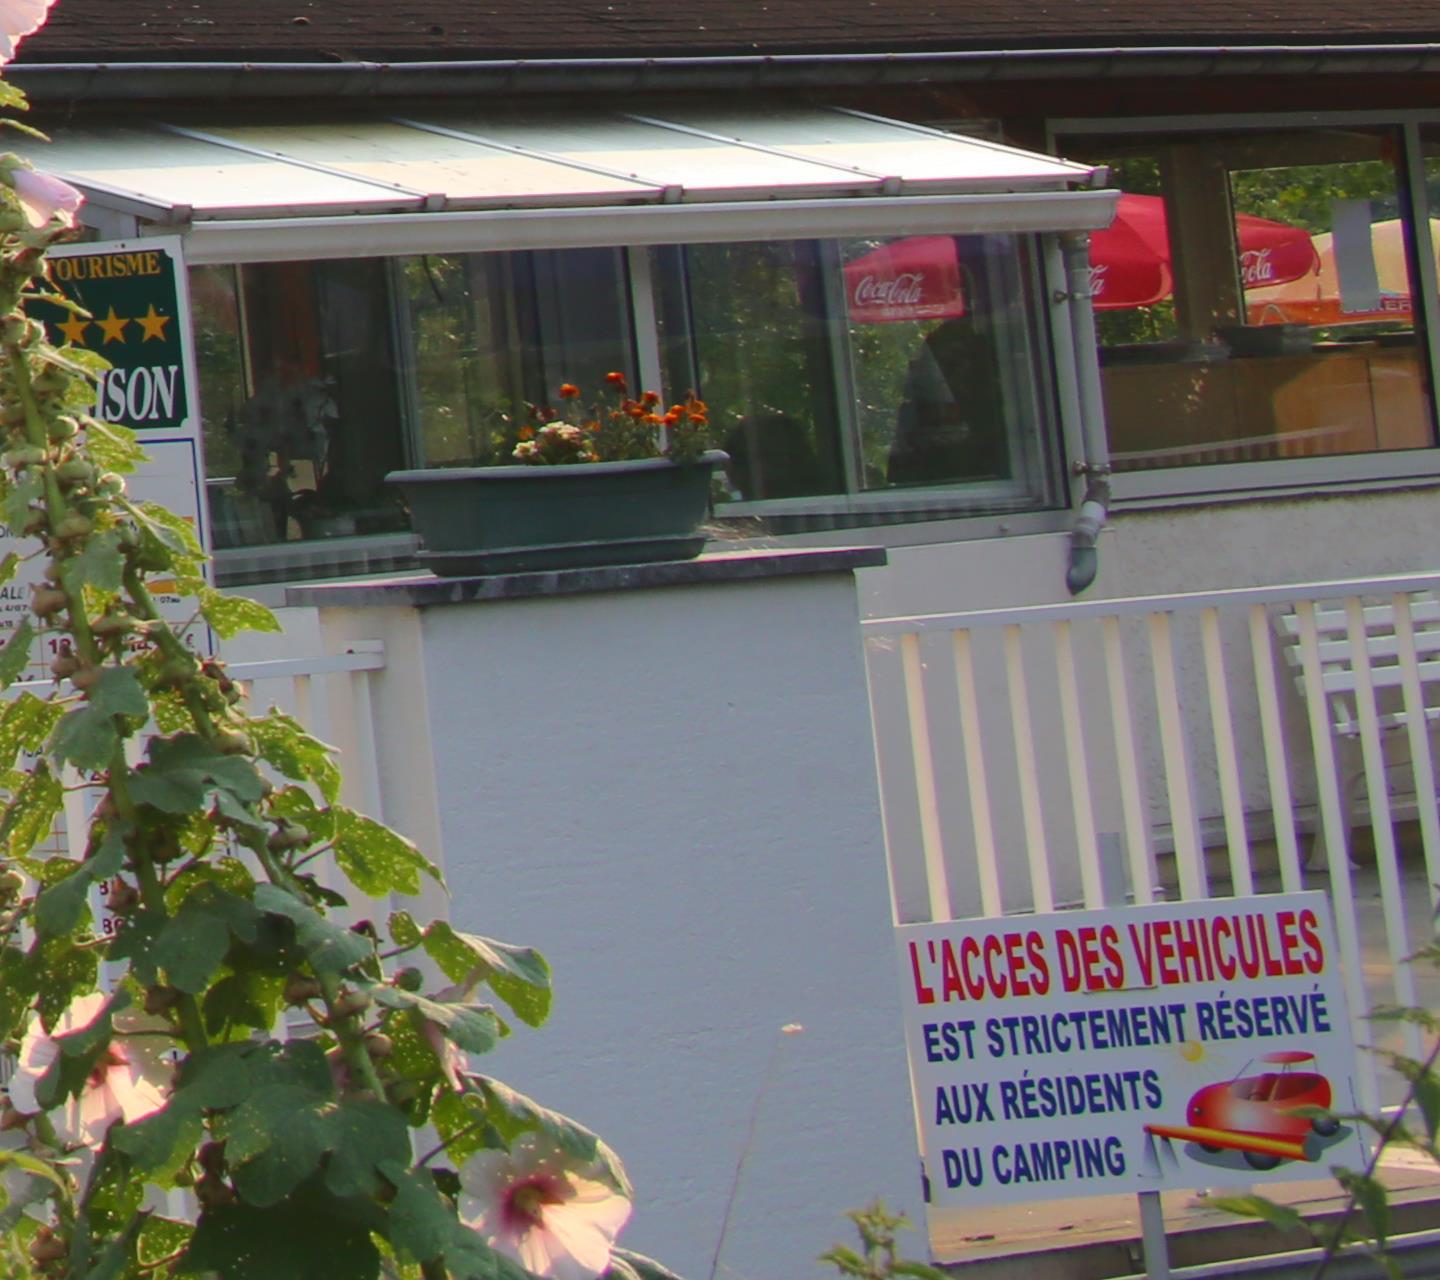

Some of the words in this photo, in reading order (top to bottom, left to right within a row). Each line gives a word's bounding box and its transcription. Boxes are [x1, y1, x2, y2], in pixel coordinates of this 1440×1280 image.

[909, 931, 1049, 1004] L'ACCES
[1055, 924, 1124, 993] DES
[1128, 908, 1324, 987] VEHICULES
[923, 1020, 976, 1062] EST
[986, 1004, 1186, 1058] STRICTEMENT
[1196, 984, 1332, 1040] RÉSERVÉ
[935, 1082, 995, 1126] AUX
[1000, 1069, 1162, 1121] RÉSIDENTS
[942, 1147, 984, 1188] DU
[992, 1136, 1126, 1184] CAMPING
